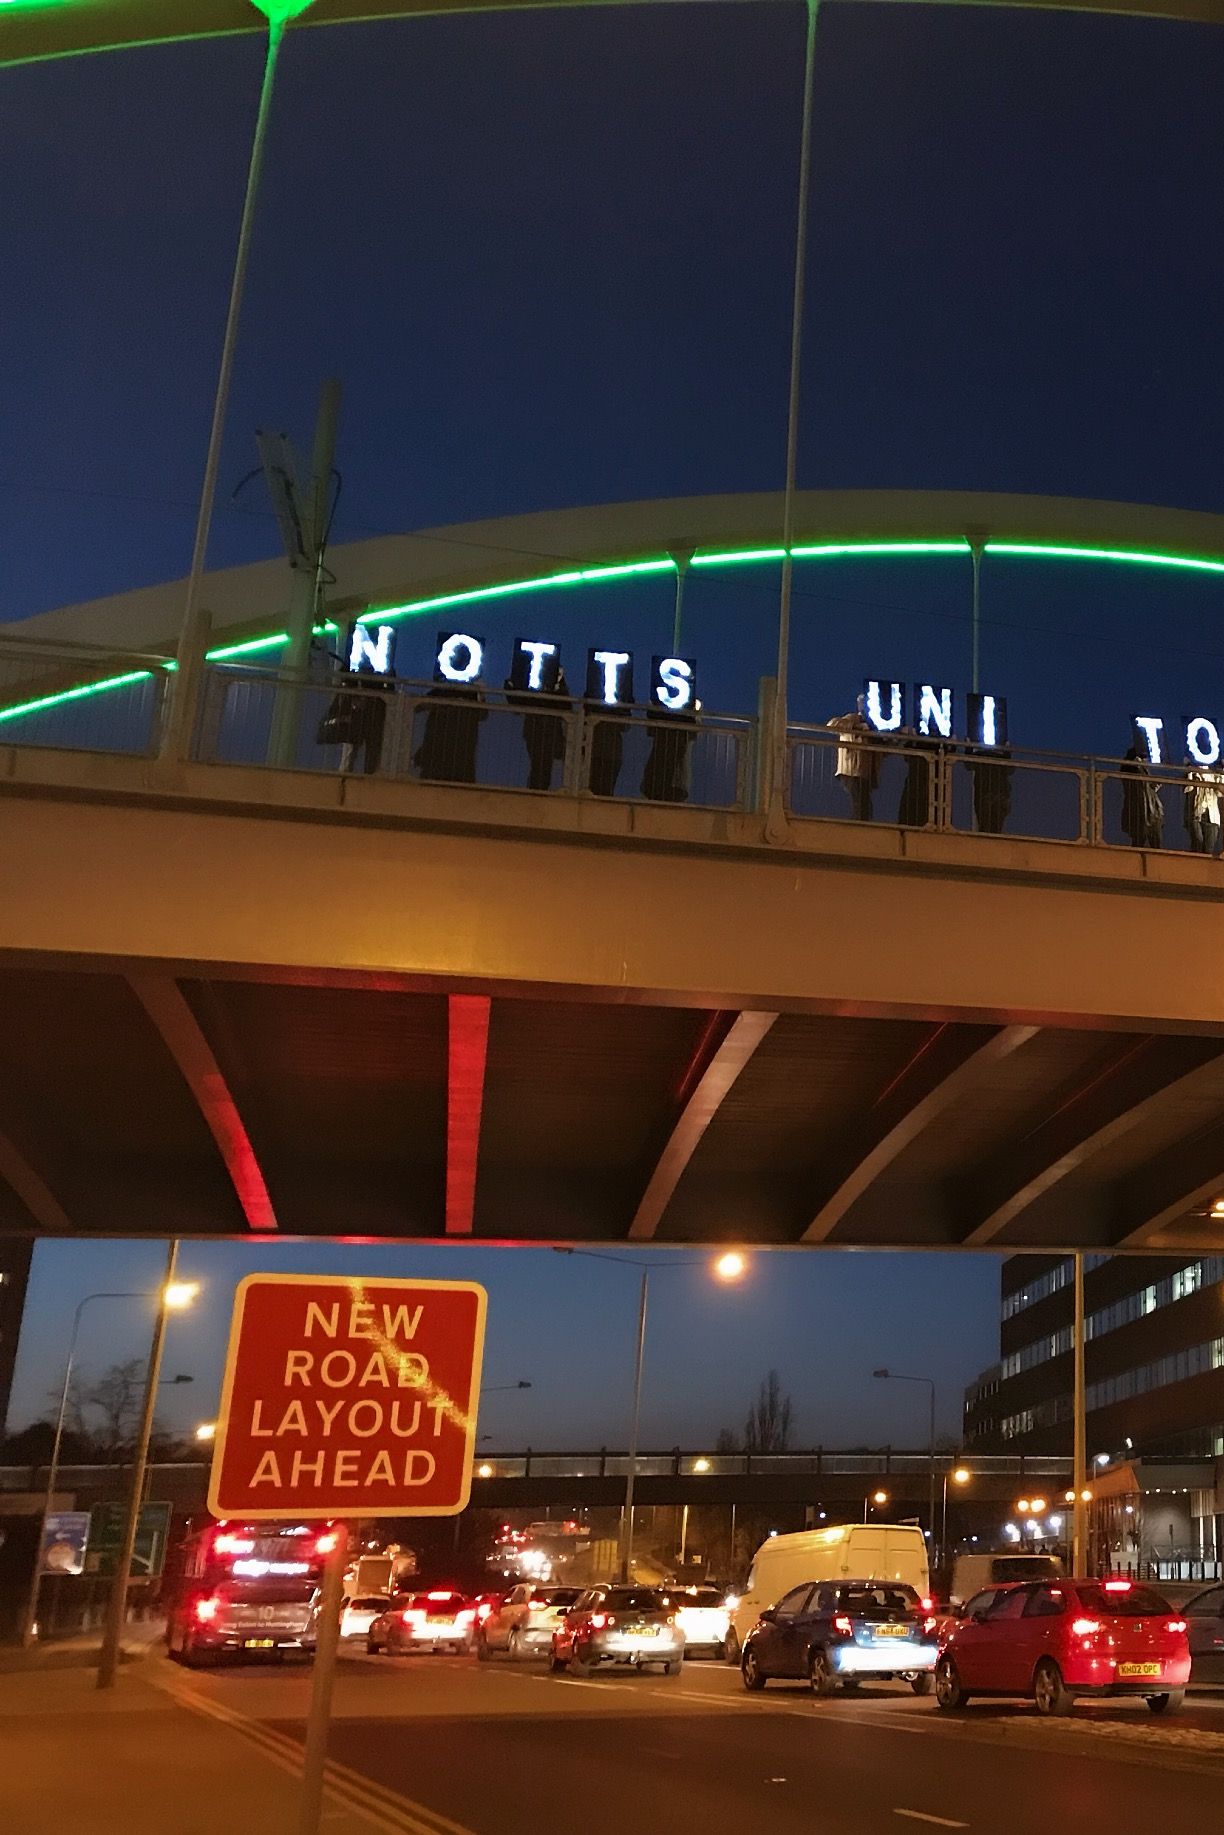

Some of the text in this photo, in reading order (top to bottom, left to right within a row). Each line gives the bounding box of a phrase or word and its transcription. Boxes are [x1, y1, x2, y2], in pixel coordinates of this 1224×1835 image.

[350, 624, 693, 709] NOTTS
[867, 681, 996, 746] UNI
[304, 1301, 425, 1340] NEW
[284, 1350, 430, 1388] ROAD
[250, 1399, 455, 1438] LAYOUT
[248, 1449, 437, 1488] AHEAD
